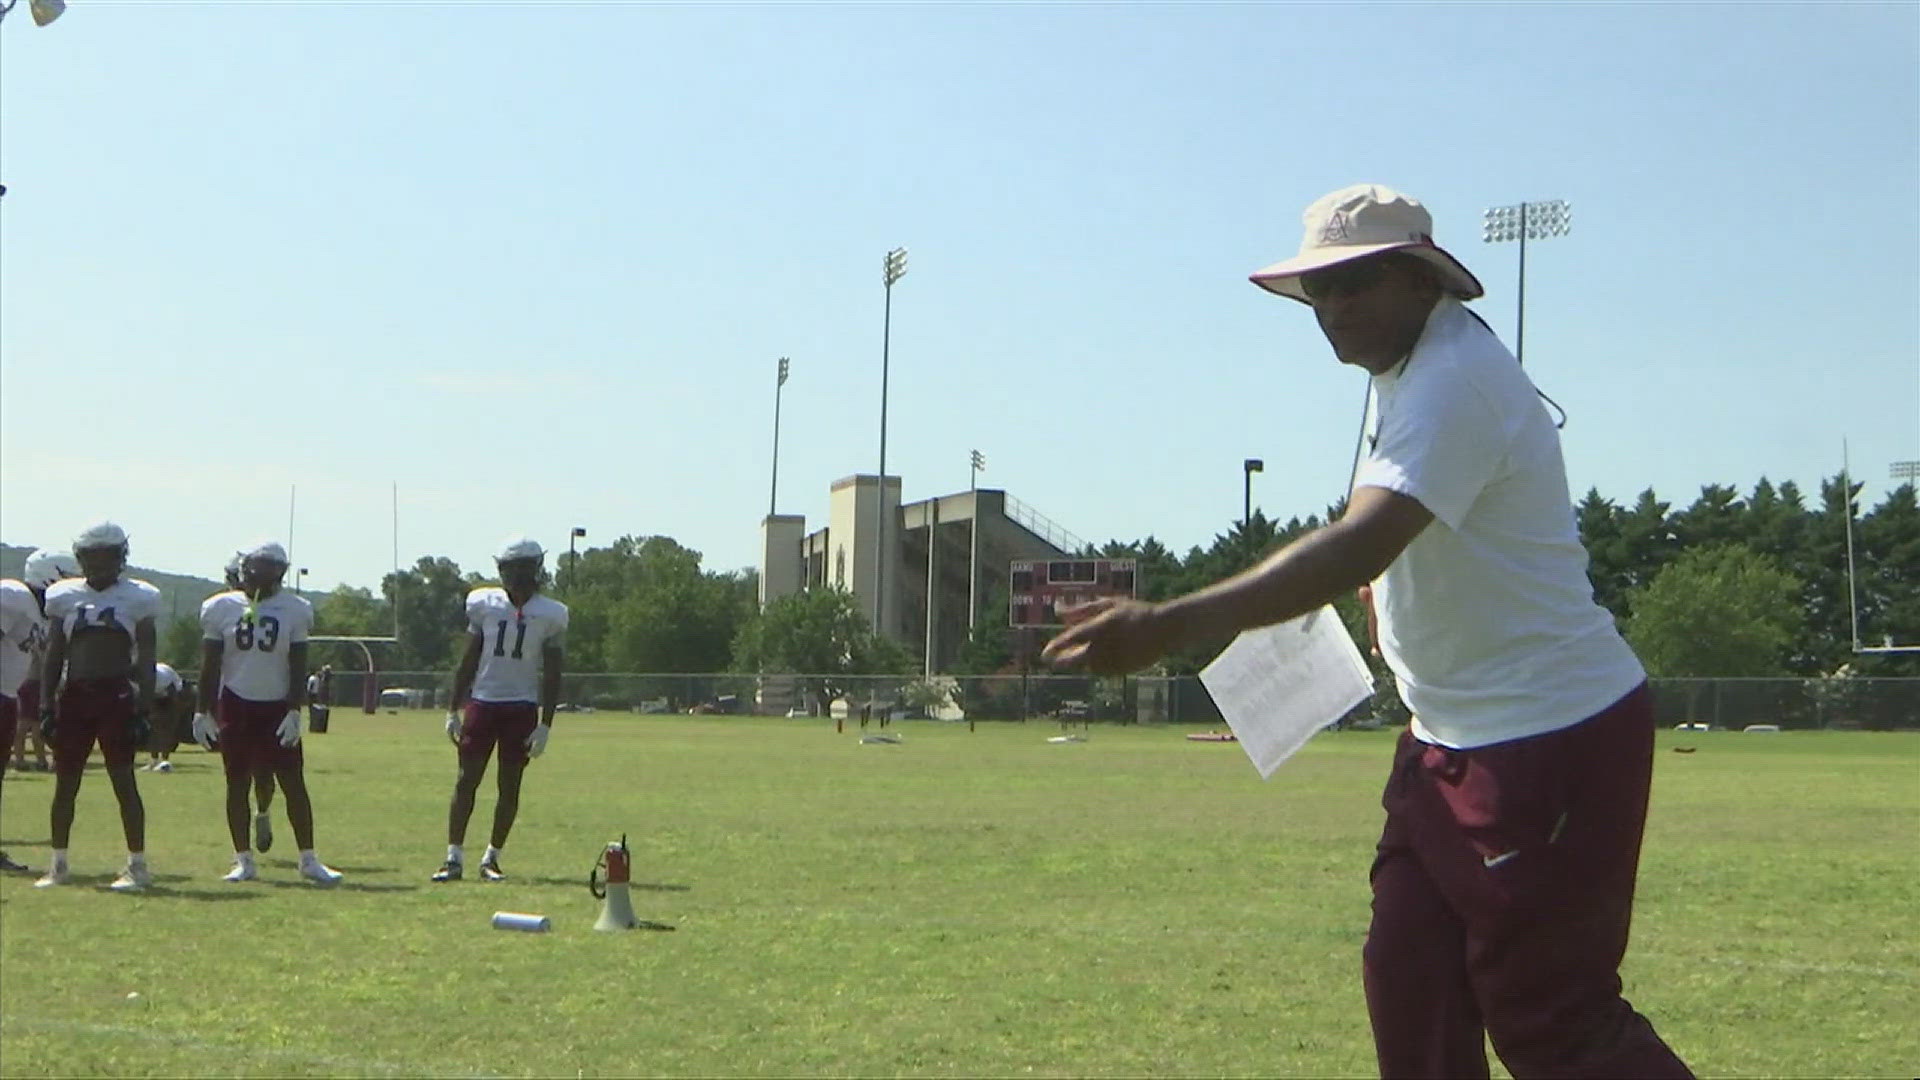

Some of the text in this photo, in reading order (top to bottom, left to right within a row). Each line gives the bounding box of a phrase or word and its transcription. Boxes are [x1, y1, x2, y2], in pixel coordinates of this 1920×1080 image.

[1013, 595, 1034, 605] DOWN
[1042, 595, 1052, 605] TO
[235, 616, 280, 652] 83
[493, 619, 527, 659] 11
